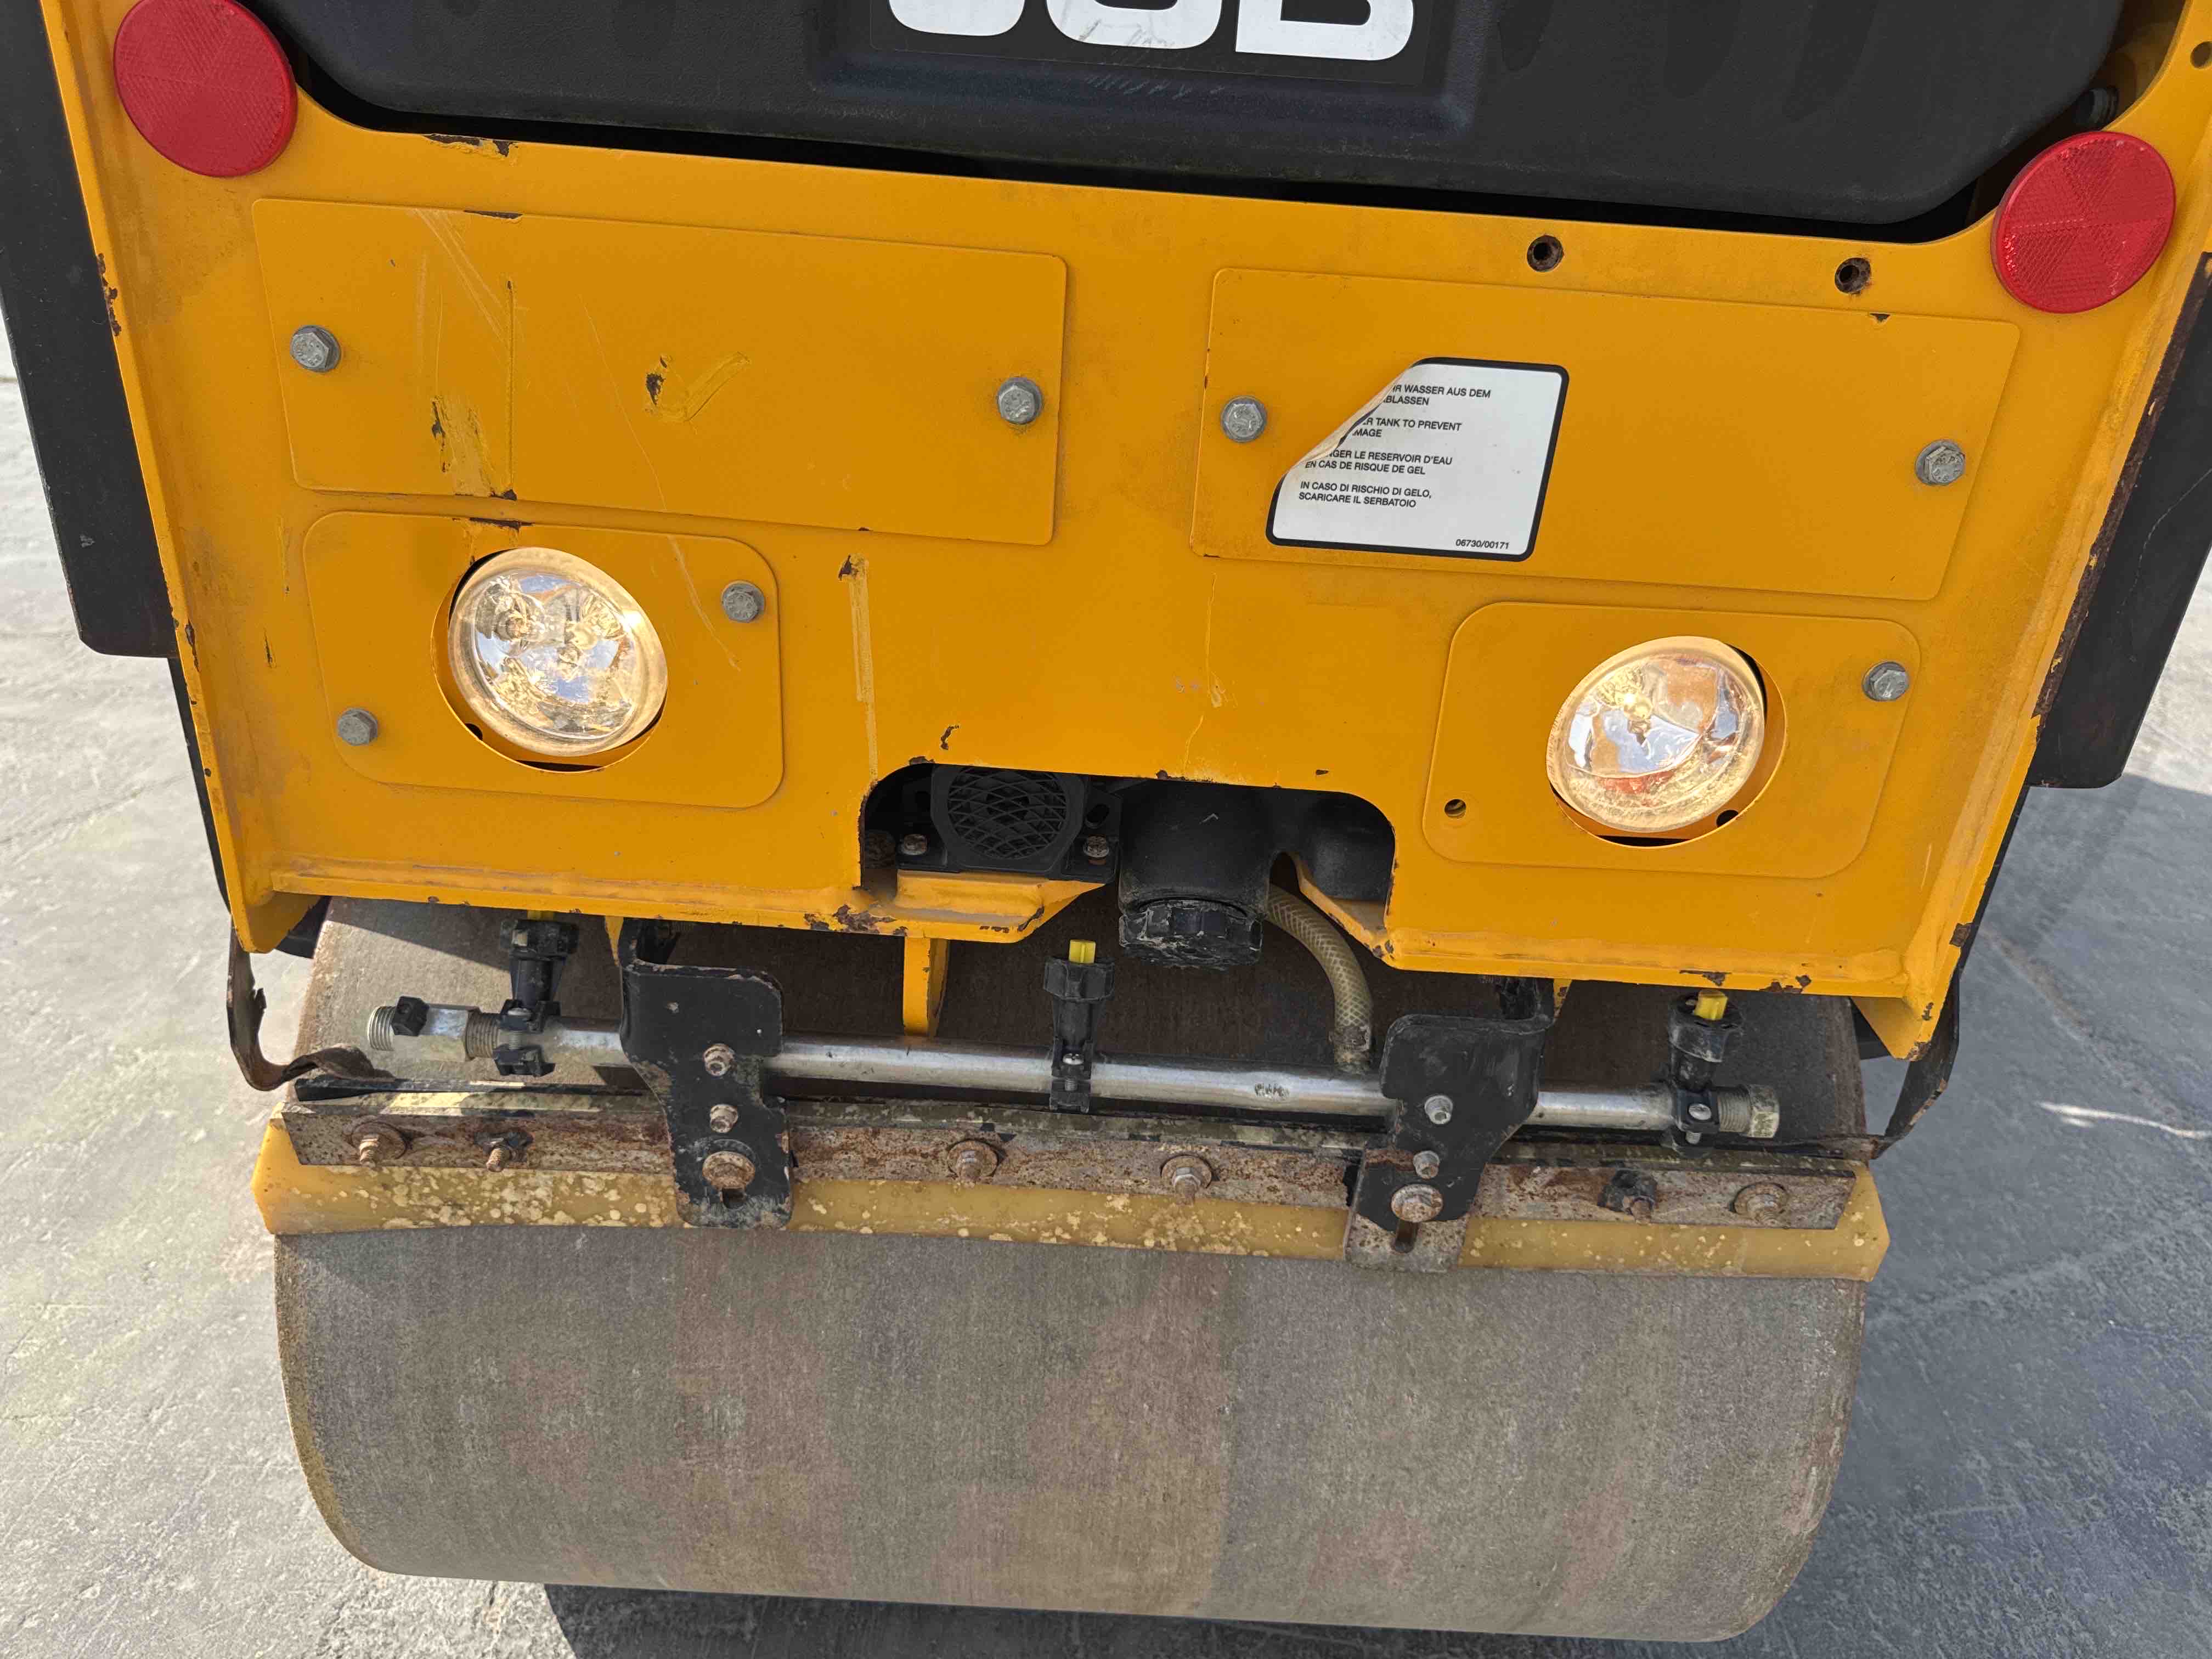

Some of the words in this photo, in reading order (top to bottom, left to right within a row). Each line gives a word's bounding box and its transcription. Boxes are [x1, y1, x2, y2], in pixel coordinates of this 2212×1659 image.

[1404, 384, 1444, 395] WASSER
[1446, 387, 1467, 397] AUS
[1469, 388, 1491, 398] DEM
[1383, 395, 1430, 405] BLASSEN
[1362, 417, 1374, 426] R
[1375, 417, 1401, 427] TANK
[1402, 419, 1415, 428] TO
[1418, 420, 1462, 431] PREVENT
[1352, 428, 1383, 438] MAGE
[1354, 450, 1366, 459] LE
[1368, 452, 1421, 463] RESERVOIR
[1423, 455, 1453, 465] D'EAU
[1305, 460, 1317, 469] EN
[1318, 460, 1338, 469] CAS
[1339, 461, 1353, 470] DE
[1354, 462, 1390, 472] RISQUE
[1391, 465, 1405, 473] DE
[1407, 466, 1426, 475] GEL
[1300, 481, 1310, 489] IN
[1312, 482, 1338, 491] CASO
[1340, 483, 1350, 492] DI
[1351, 484, 1390, 495] RISCHIO
[1392, 487, 1402, 495] DI
[1404, 488, 1432, 499] GELO,
[1299, 492, 1351, 503] SCARICARE
[1353, 495, 1361, 504] IL
[1363, 496, 1417, 508] SERBATOIO
[1455, 539, 1509, 549] 06730/00171
